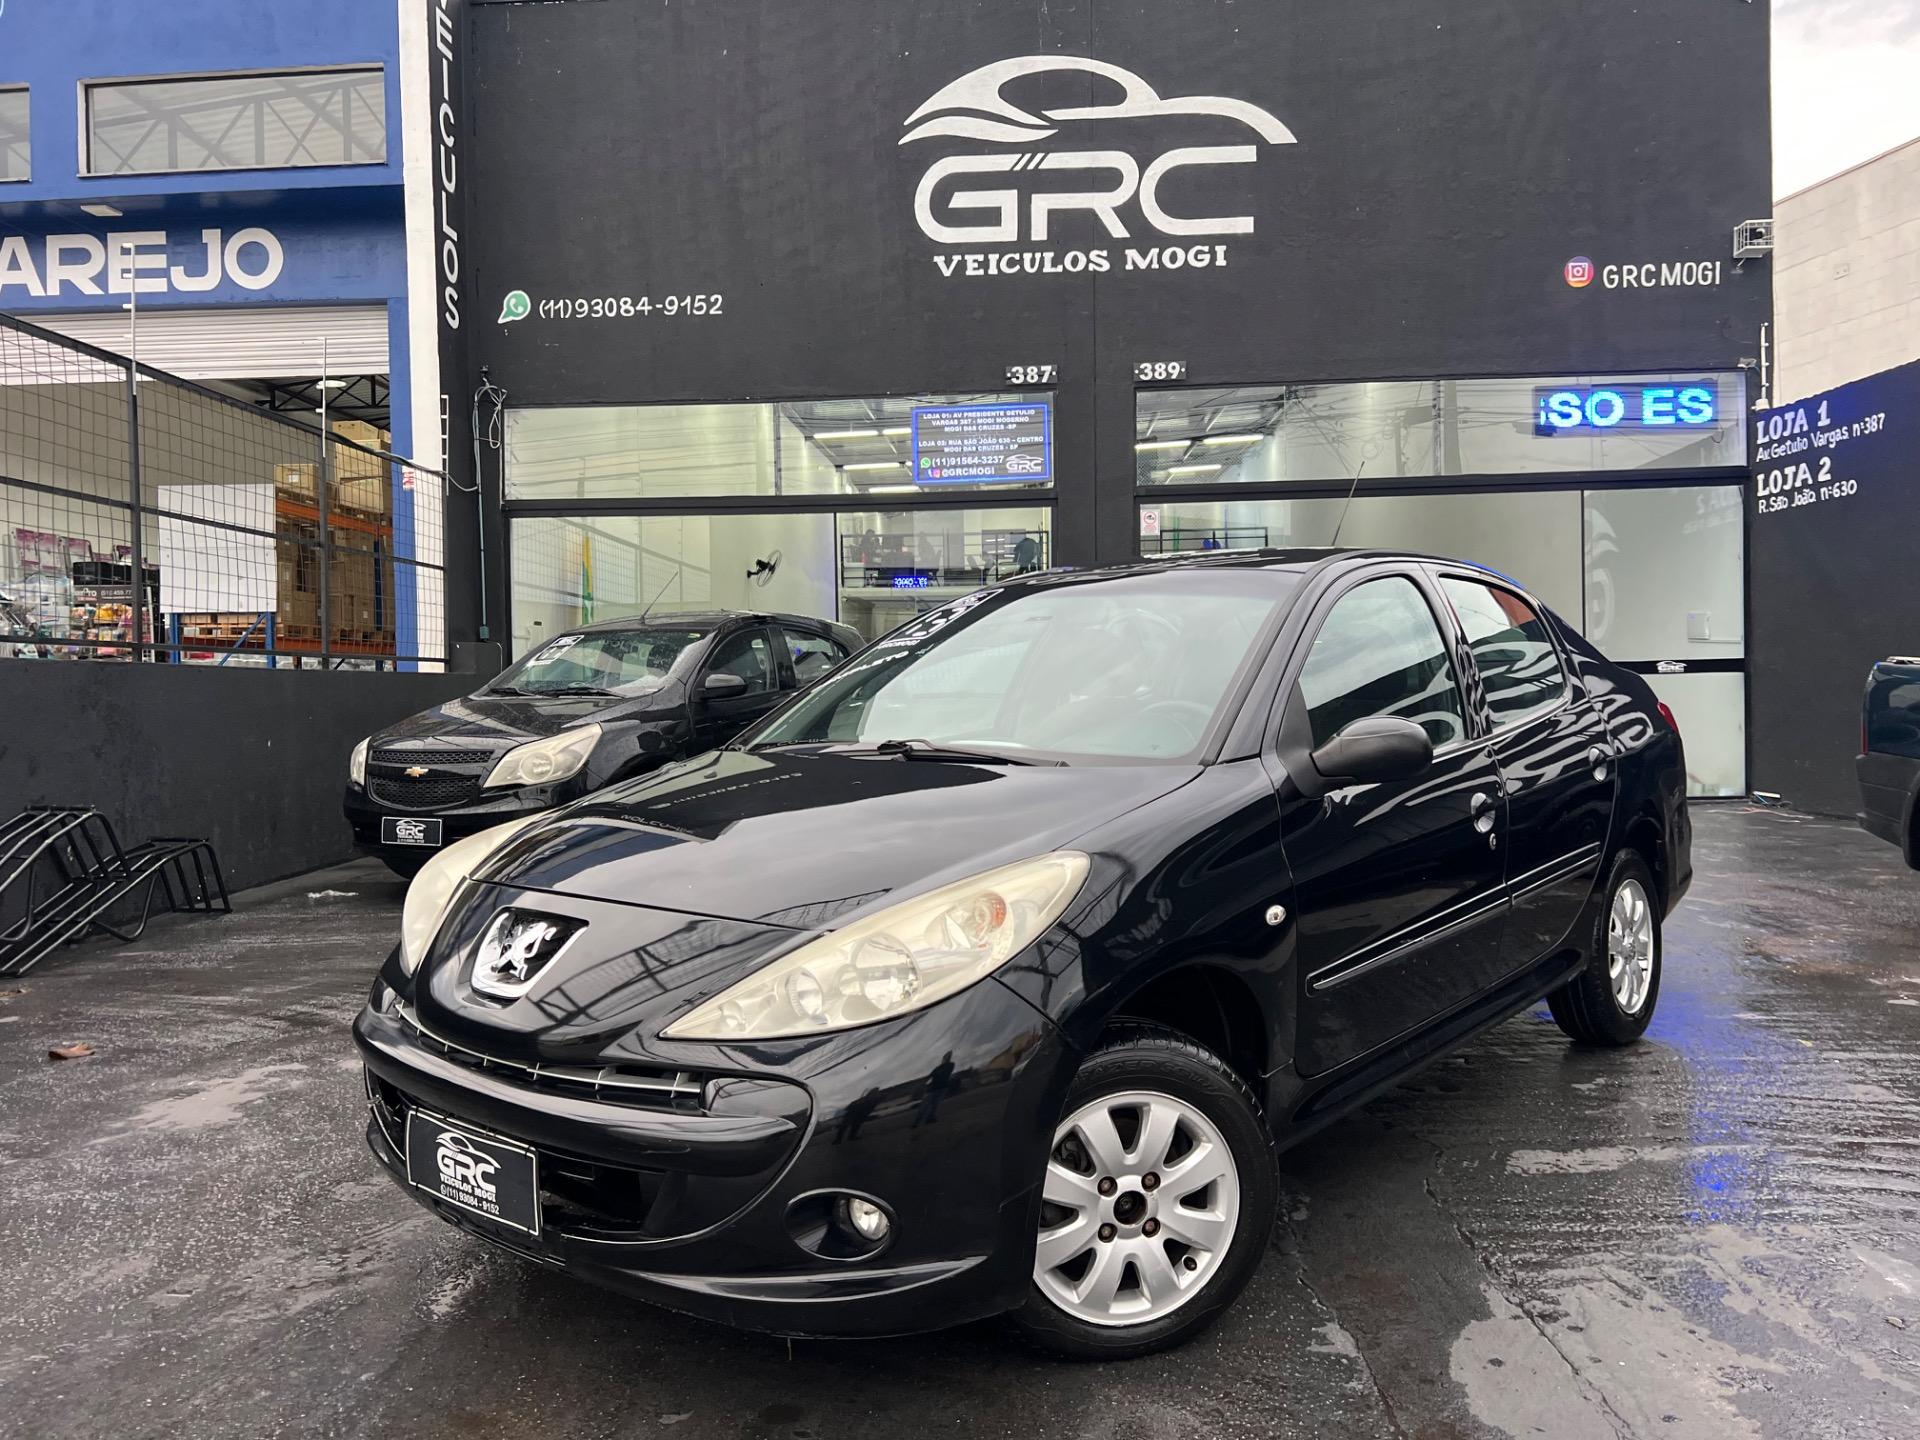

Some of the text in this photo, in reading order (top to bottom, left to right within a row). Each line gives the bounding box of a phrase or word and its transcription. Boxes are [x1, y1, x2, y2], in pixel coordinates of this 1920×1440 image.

[436, 0, 460, 329] EICULOS
[914, 145, 1257, 243] GRC
[0, 227, 284, 296] AREJO
[933, 245, 1228, 277] VEICULOS MOGI
[539, 294, 723, 319] (11)93084-9152
[1011, 366, 1052, 384] 387
[1139, 362, 1180, 381] 389
[964, 410, 1005, 418] PRESIDENTE
[1540, 388, 1713, 428] SO ES
[1756, 400, 1831, 444] LOJA 1
[1006, 460, 1042, 471] GRC
[1756, 456, 1831, 496] LOJA 2
[396, 825, 424, 837] GRC
[437, 1146, 497, 1194] GRC
[474, 1187, 497, 1203] MOGI
